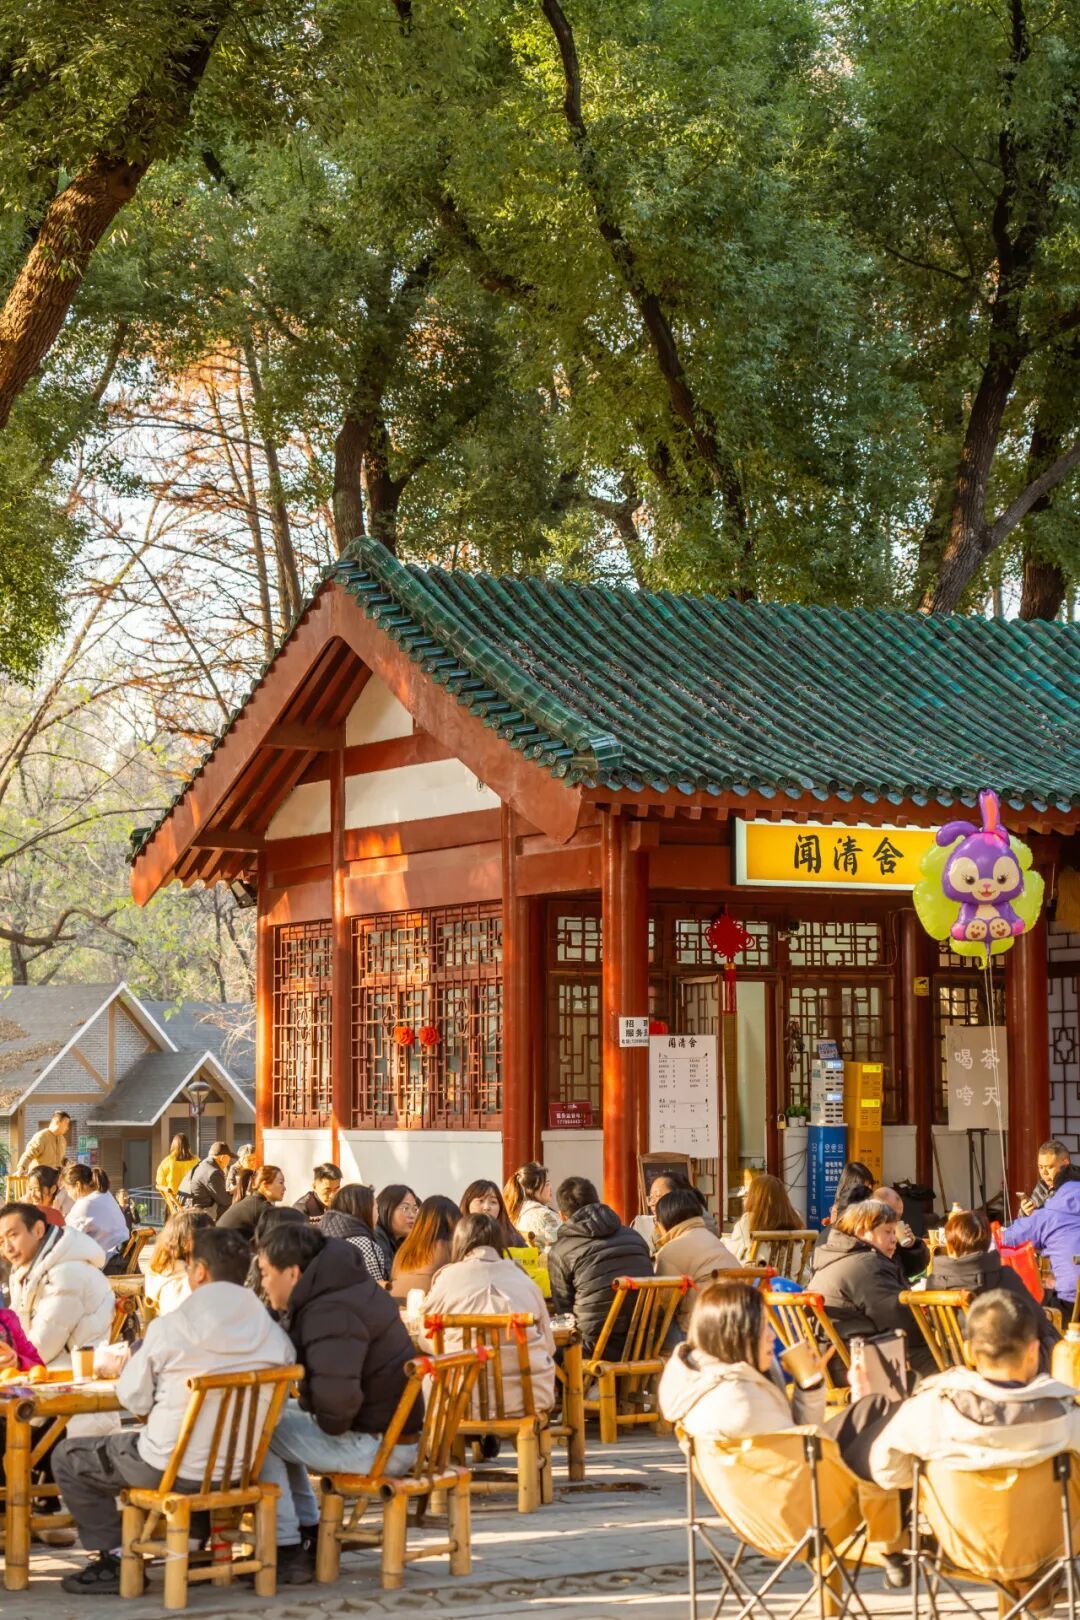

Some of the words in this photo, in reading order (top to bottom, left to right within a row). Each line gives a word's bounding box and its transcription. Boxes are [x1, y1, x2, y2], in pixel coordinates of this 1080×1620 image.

[793, 834, 904, 875] 闻清舍
[954, 1048, 1000, 1070] 喝茶
